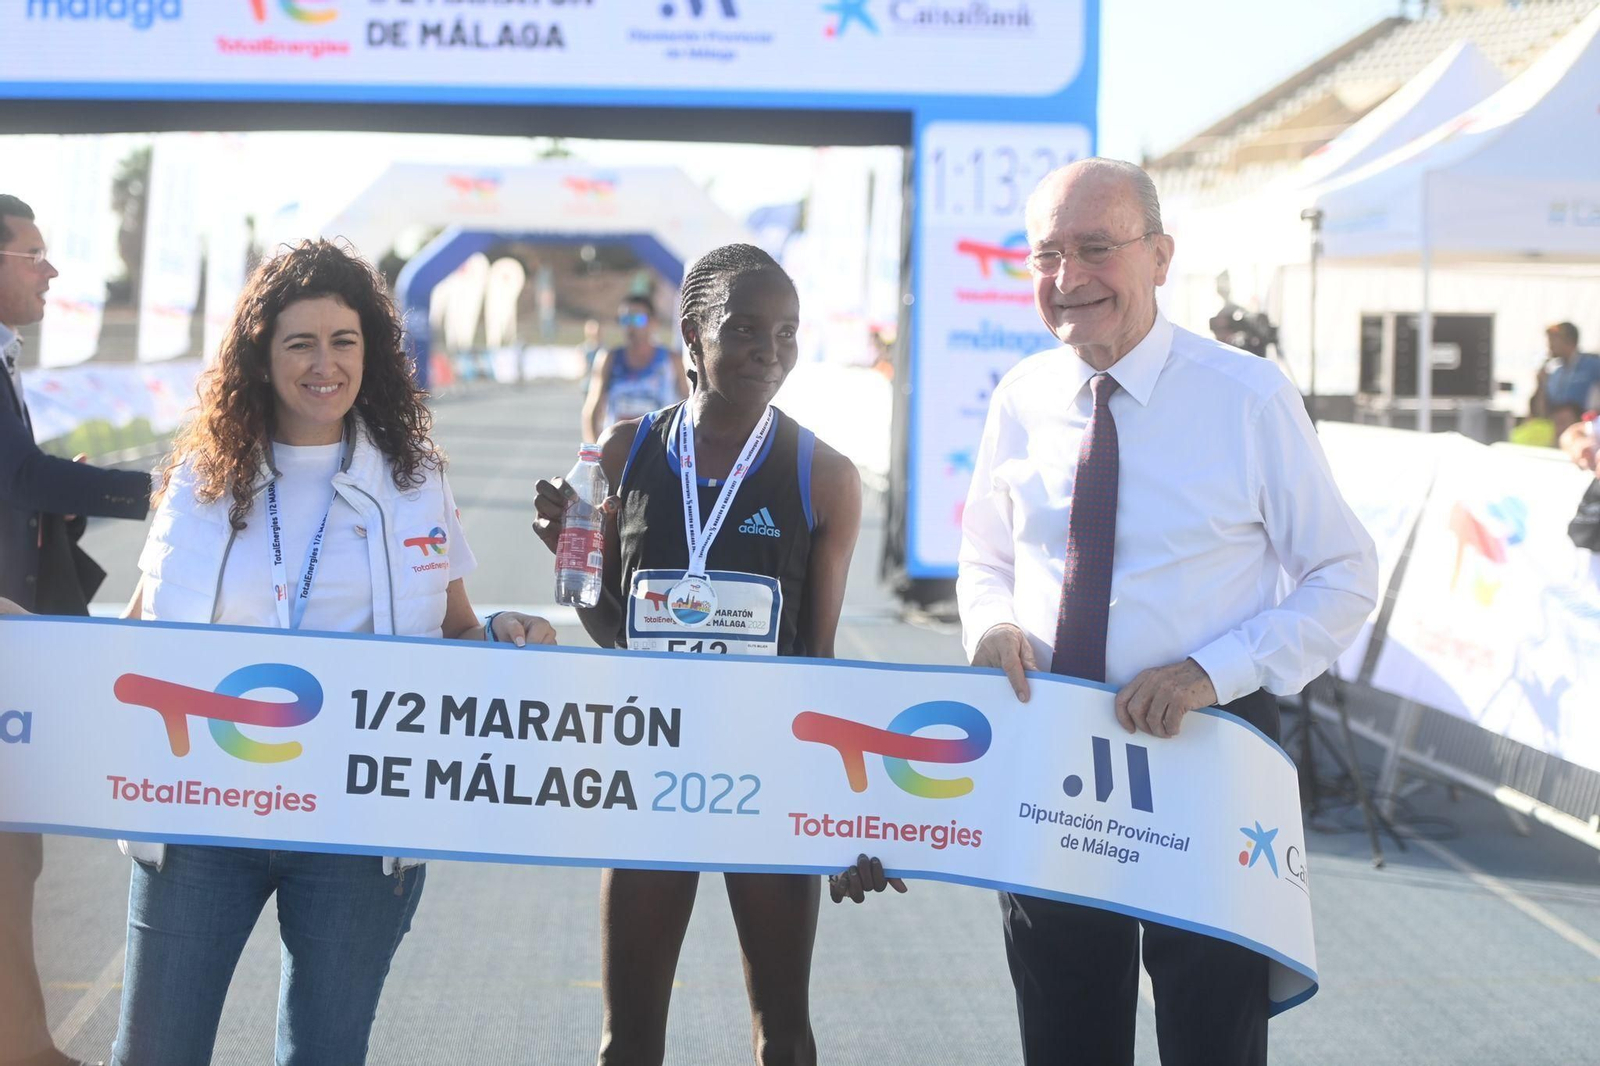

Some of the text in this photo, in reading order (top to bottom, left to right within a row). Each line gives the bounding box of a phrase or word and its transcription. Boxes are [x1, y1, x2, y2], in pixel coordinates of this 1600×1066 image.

[366, 20, 407, 47] DE
[930, 147, 1078, 216] 1:13:2
[268, 503, 278, 515] 1/2
[270, 516, 282, 566] TotalEnergies
[738, 522, 781, 538] adidas
[300, 548, 319, 600] TotalEnergies
[412, 561, 449, 573] TotalEnergi
[643, 616, 677, 625] TotalEner
[712, 618, 746, 628] MÁLAGA
[747, 620, 766, 630] 2022
[714, 608, 753, 618] MARATÓN
[350, 688, 682, 748] 1/2 MARATÓN
[106, 774, 318, 816] TotalEnergies
[346, 752, 762, 815] DE MÁLAGA 2022
[788, 812, 983, 850] TotalEnergies
[1018, 802, 1191, 852] Diputación Provincial
[1060, 833, 1140, 864] de Málaga
